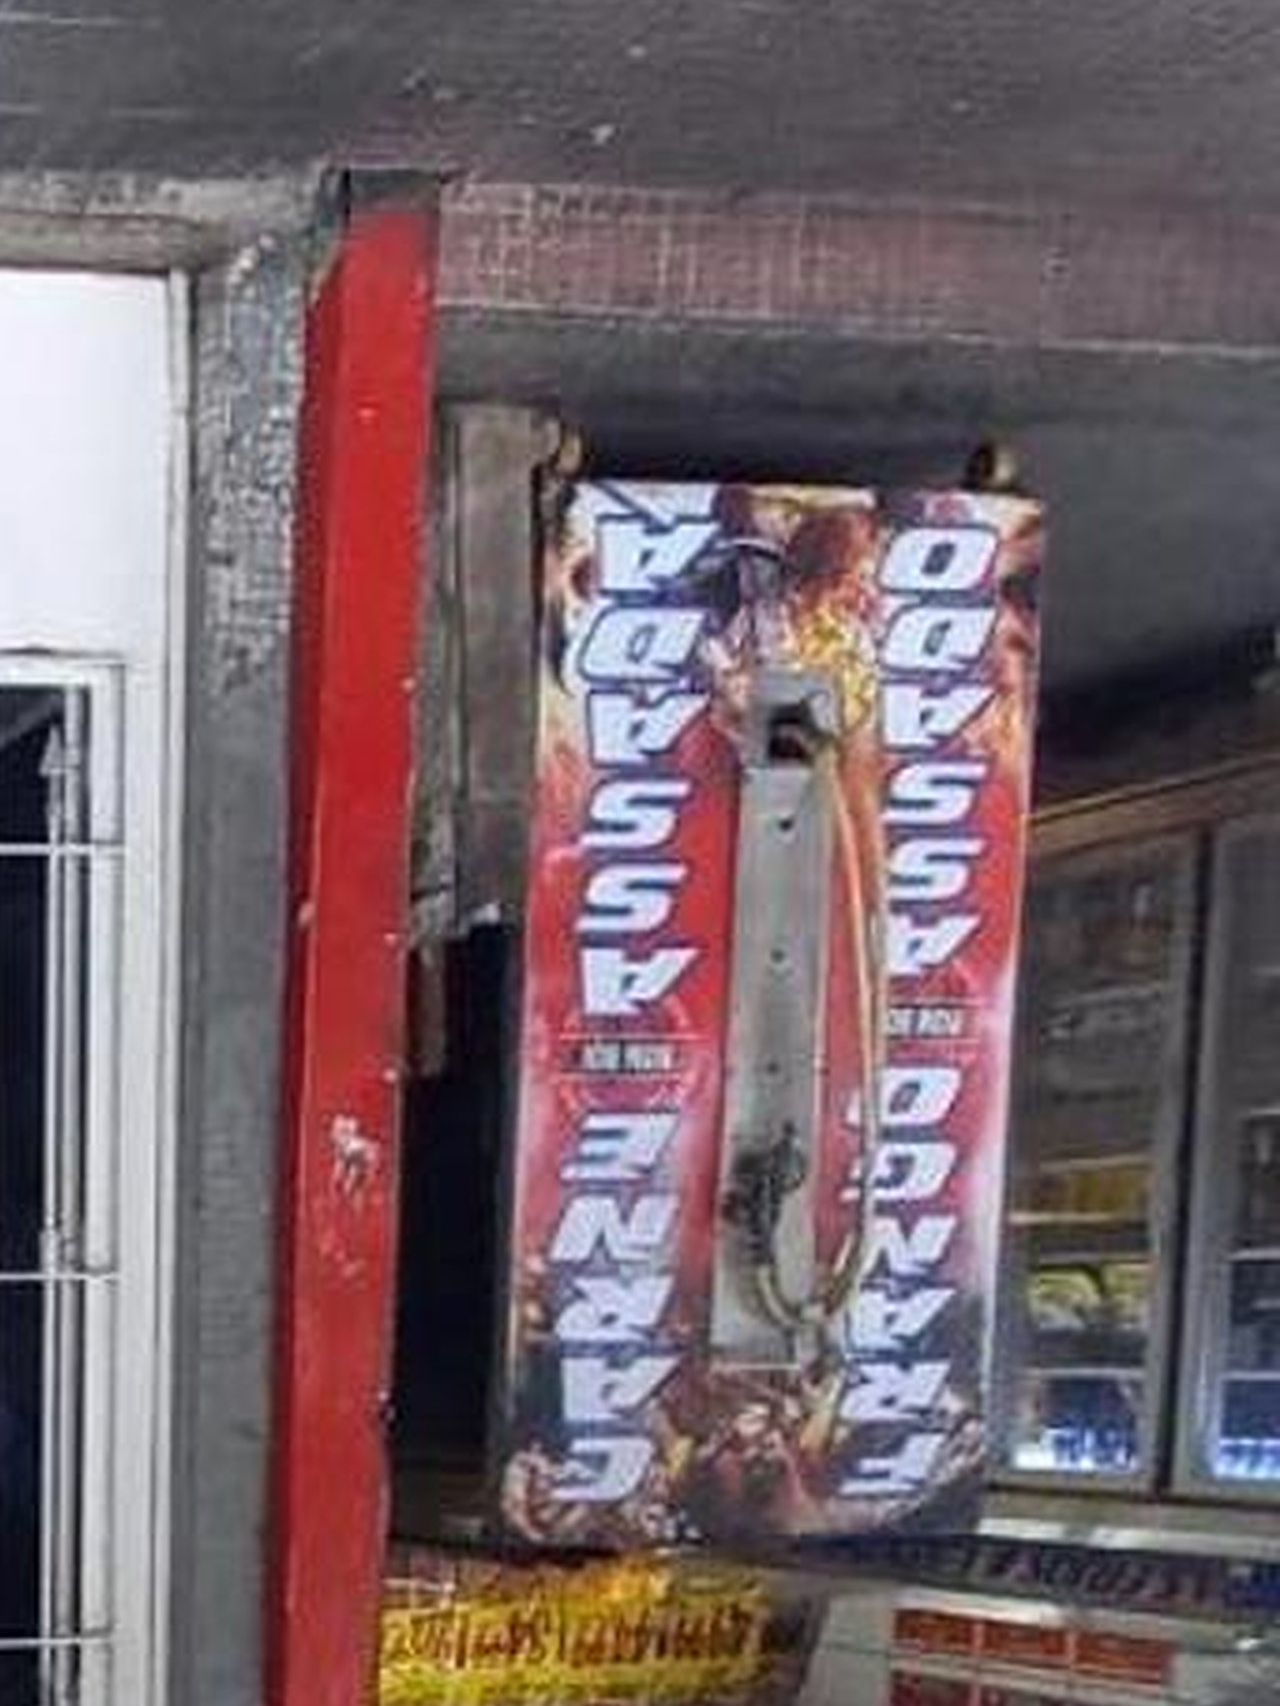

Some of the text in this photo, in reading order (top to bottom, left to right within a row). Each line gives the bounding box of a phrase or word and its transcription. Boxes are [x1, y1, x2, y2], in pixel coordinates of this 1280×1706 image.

[575, 518, 718, 1016] ASSADA
[875, 525, 999, 978] ASSADO
[550, 1112, 678, 1502] CARNE
[840, 1062, 965, 1495] FRANGO
